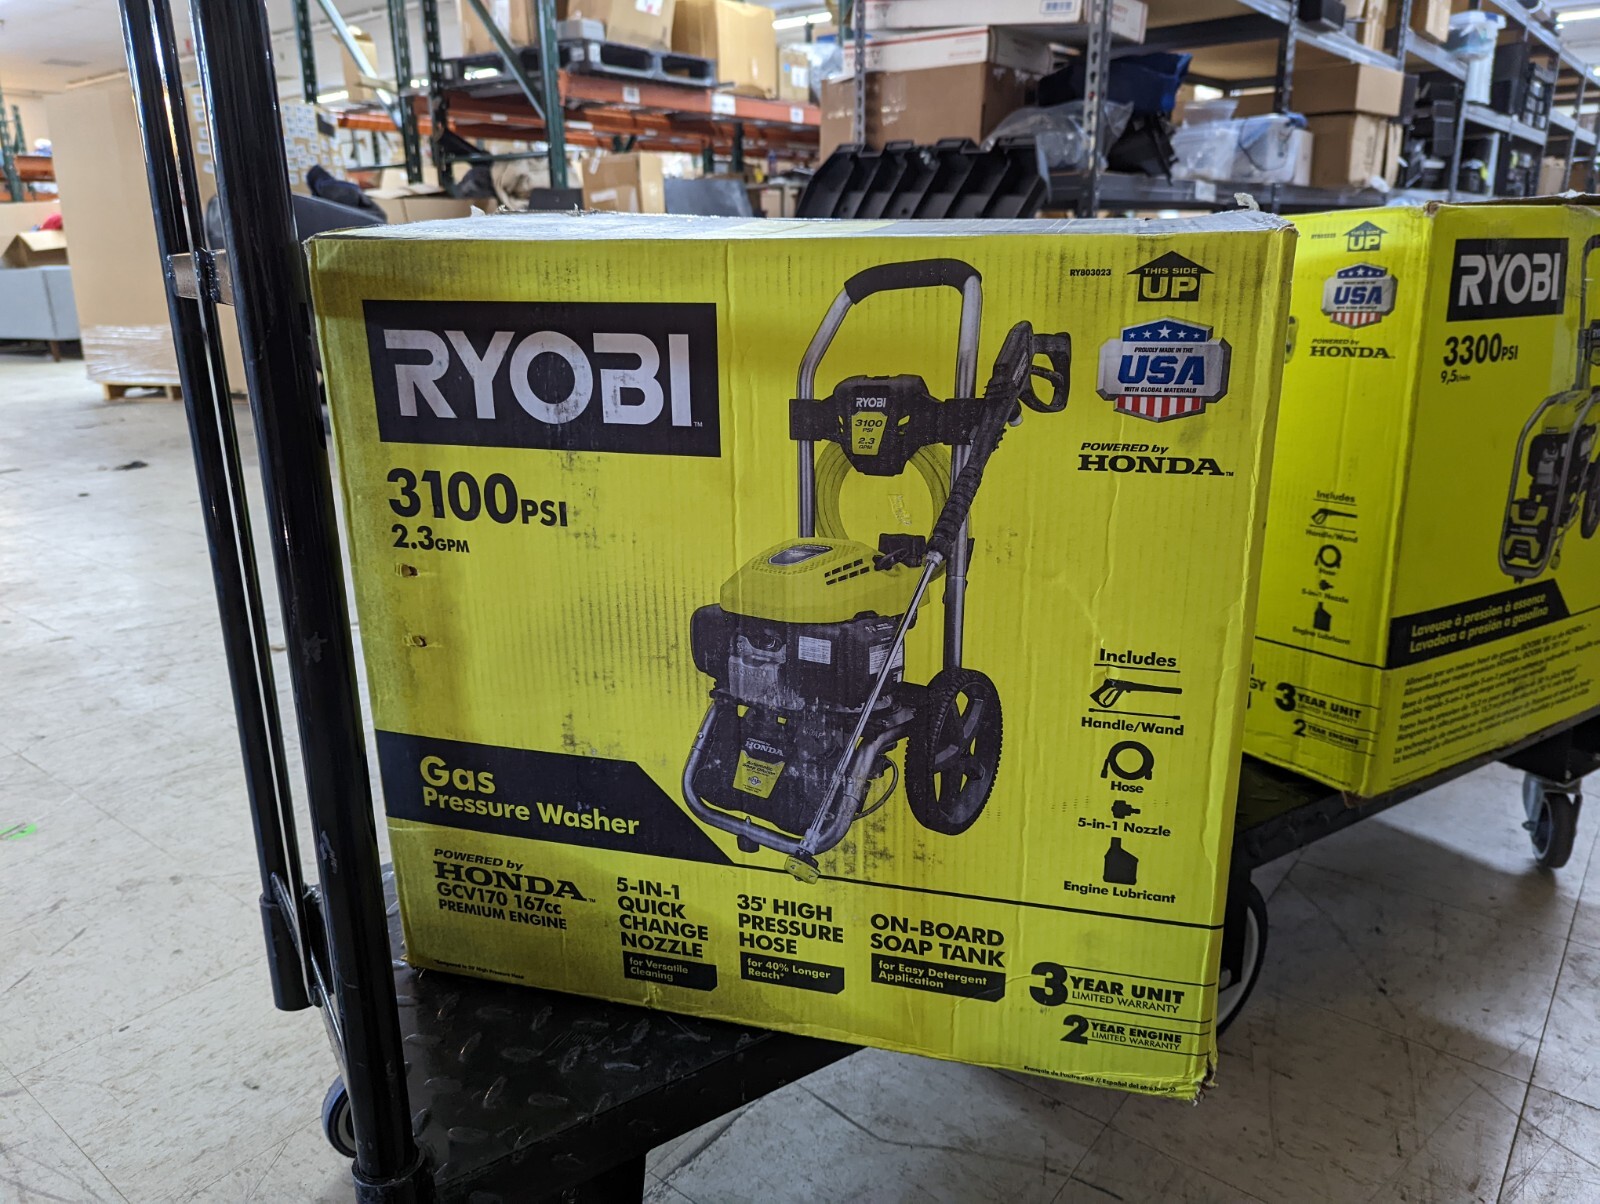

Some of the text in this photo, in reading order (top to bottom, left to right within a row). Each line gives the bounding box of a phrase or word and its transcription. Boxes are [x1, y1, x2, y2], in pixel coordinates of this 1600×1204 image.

[1348, 235, 1380, 251] UP
[1070, 268, 1112, 277] RY803023
[1144, 267, 1198, 275] THIS SIDE
[1458, 252, 1561, 307] RYOBI
[1142, 276, 1198, 299] UP
[1333, 286, 1383, 305] USA
[1309, 346, 1390, 359] HONDA
[383, 329, 692, 427] RYOBI
[1117, 355, 1206, 386] USA
[1163, 386, 1197, 394] MATERIALS
[855, 397, 887, 408] RYOBI
[855, 419, 883, 428] 3100
[857, 437, 876, 445] 2.3
[1080, 442, 1169, 455] POWERED by
[1077, 454, 1225, 477] HONDA
[1316, 490, 1355, 503] Includes
[1305, 529, 1358, 544] Handle/Wand
[1411, 615, 1452, 638] Laveuse
[1463, 605, 1503, 628] pression
[1513, 593, 1546, 610] essence
[1409, 631, 1457, 654] Lavadora
[1512, 605, 1548, 628] gasolina
[1099, 648, 1177, 667] Includes
[1274, 682, 1362, 718] 3 YEAR UNIT
[1081, 716, 1184, 736] Handle/Wand
[1293, 718, 1307, 737] 2
[1308, 725, 1326, 736] YEAR
[745, 740, 784, 757] HONDA
[419, 755, 496, 794] Gas
[1110, 780, 1144, 794] Hose
[422, 786, 640, 835] Pressure Washer
[1077, 817, 1171, 837] 5-in-1 Nozzle
[433, 848, 524, 872] POWERED by
[433, 860, 587, 902] HONDA
[616, 876, 680, 900] 5-IN-1
[1063, 880, 1176, 903] Engine Lubricant
[436, 881, 562, 915] GCV170 167cc
[617, 896, 686, 920] QUICK
[737, 893, 833, 923] 35' HIGH
[438, 898, 567, 930] PREMIUM ENGINE
[619, 914, 709, 941] CHANGE
[738, 912, 844, 944] PRESSURE
[870, 913, 1005, 947] ON-BOARD
[620, 932, 704, 958] NOZZLE
[739, 931, 797, 955] HOSE
[870, 932, 1006, 968] SOAP TANK
[629, 956, 689, 975] for Versatile
[630, 966, 674, 982] Cleaning
[747, 957, 831, 980] for 40% Longer
[878, 959, 988, 986] for Easy Detergent
[878, 970, 944, 990] Application
[1029, 961, 1185, 1007] 3 YEAR UNIT
[1072, 990, 1180, 1014] LIMITED WARRANTY
[1060, 1014, 1182, 1045] 2 YEAR ENGINE
[1091, 1031, 1180, 1051] LIMITED WARRANTY
